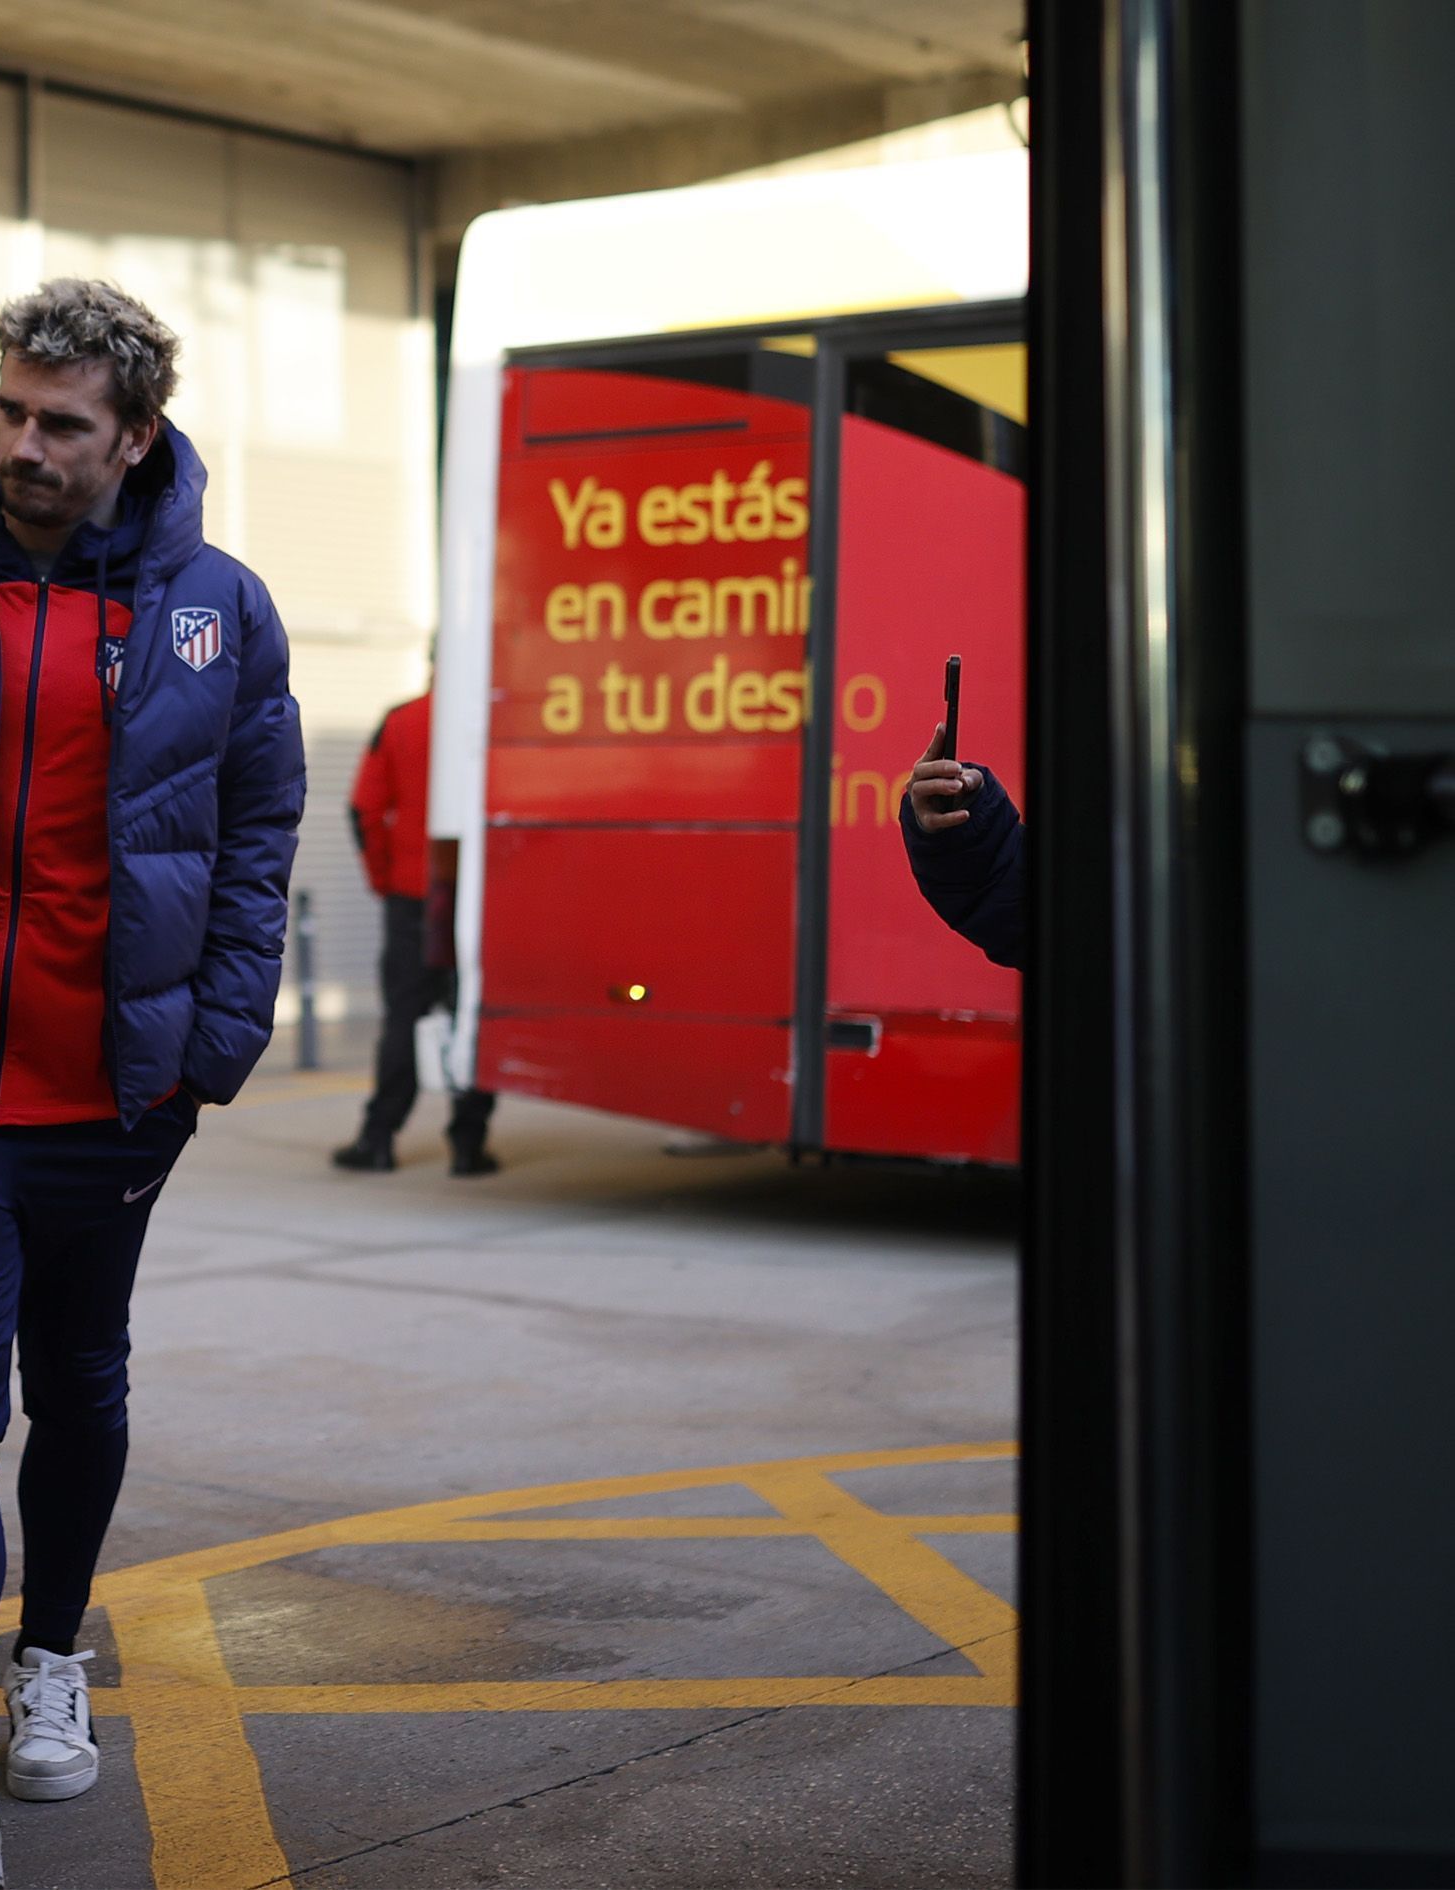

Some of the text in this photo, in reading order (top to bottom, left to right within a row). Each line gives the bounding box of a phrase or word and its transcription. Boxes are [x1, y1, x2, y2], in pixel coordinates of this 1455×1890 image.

[549, 459, 809, 549] Ya estás
[545, 581, 626, 642] en
[542, 673, 582, 735] a
[599, 660, 671, 734] tu
